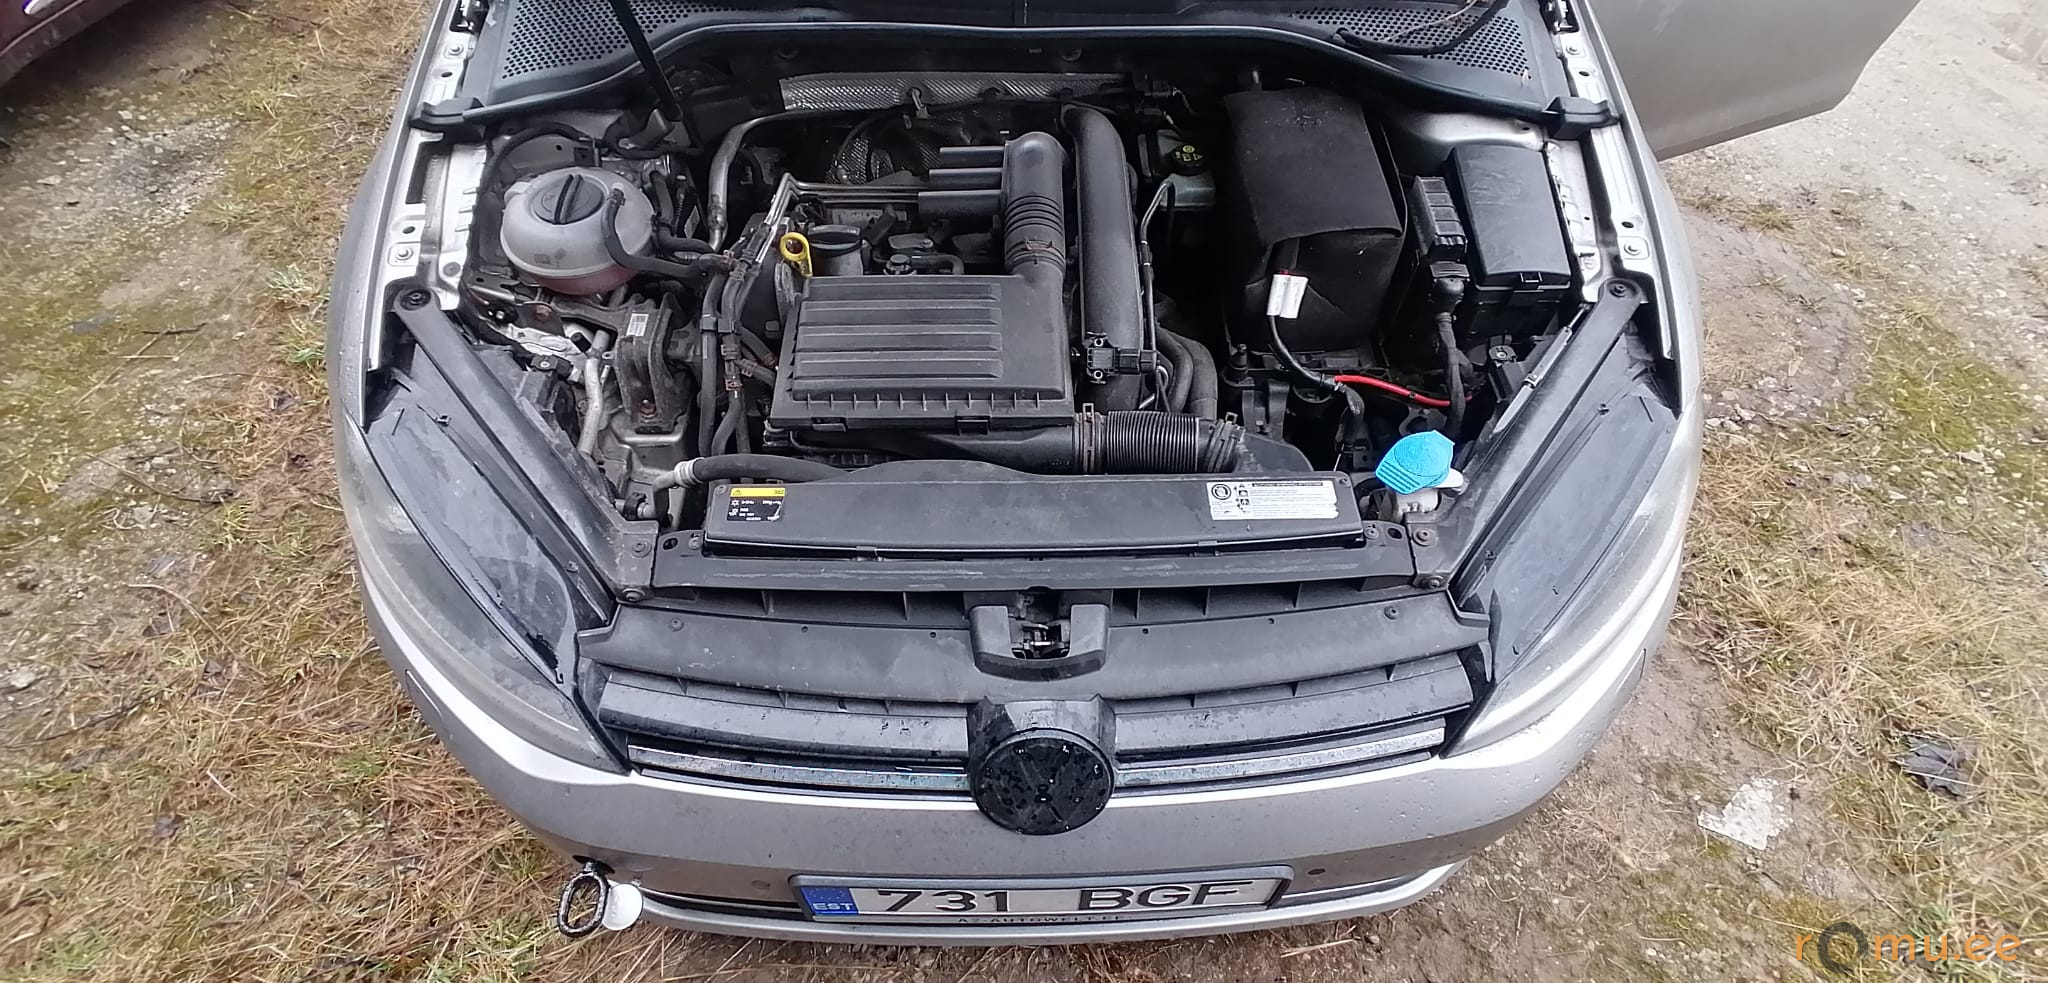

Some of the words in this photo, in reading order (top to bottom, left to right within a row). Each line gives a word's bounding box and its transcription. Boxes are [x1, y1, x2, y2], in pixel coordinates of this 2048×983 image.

[877, 889, 1009, 912] 731
[1078, 880, 1253, 911] BGF
[812, 902, 853, 911] EST
